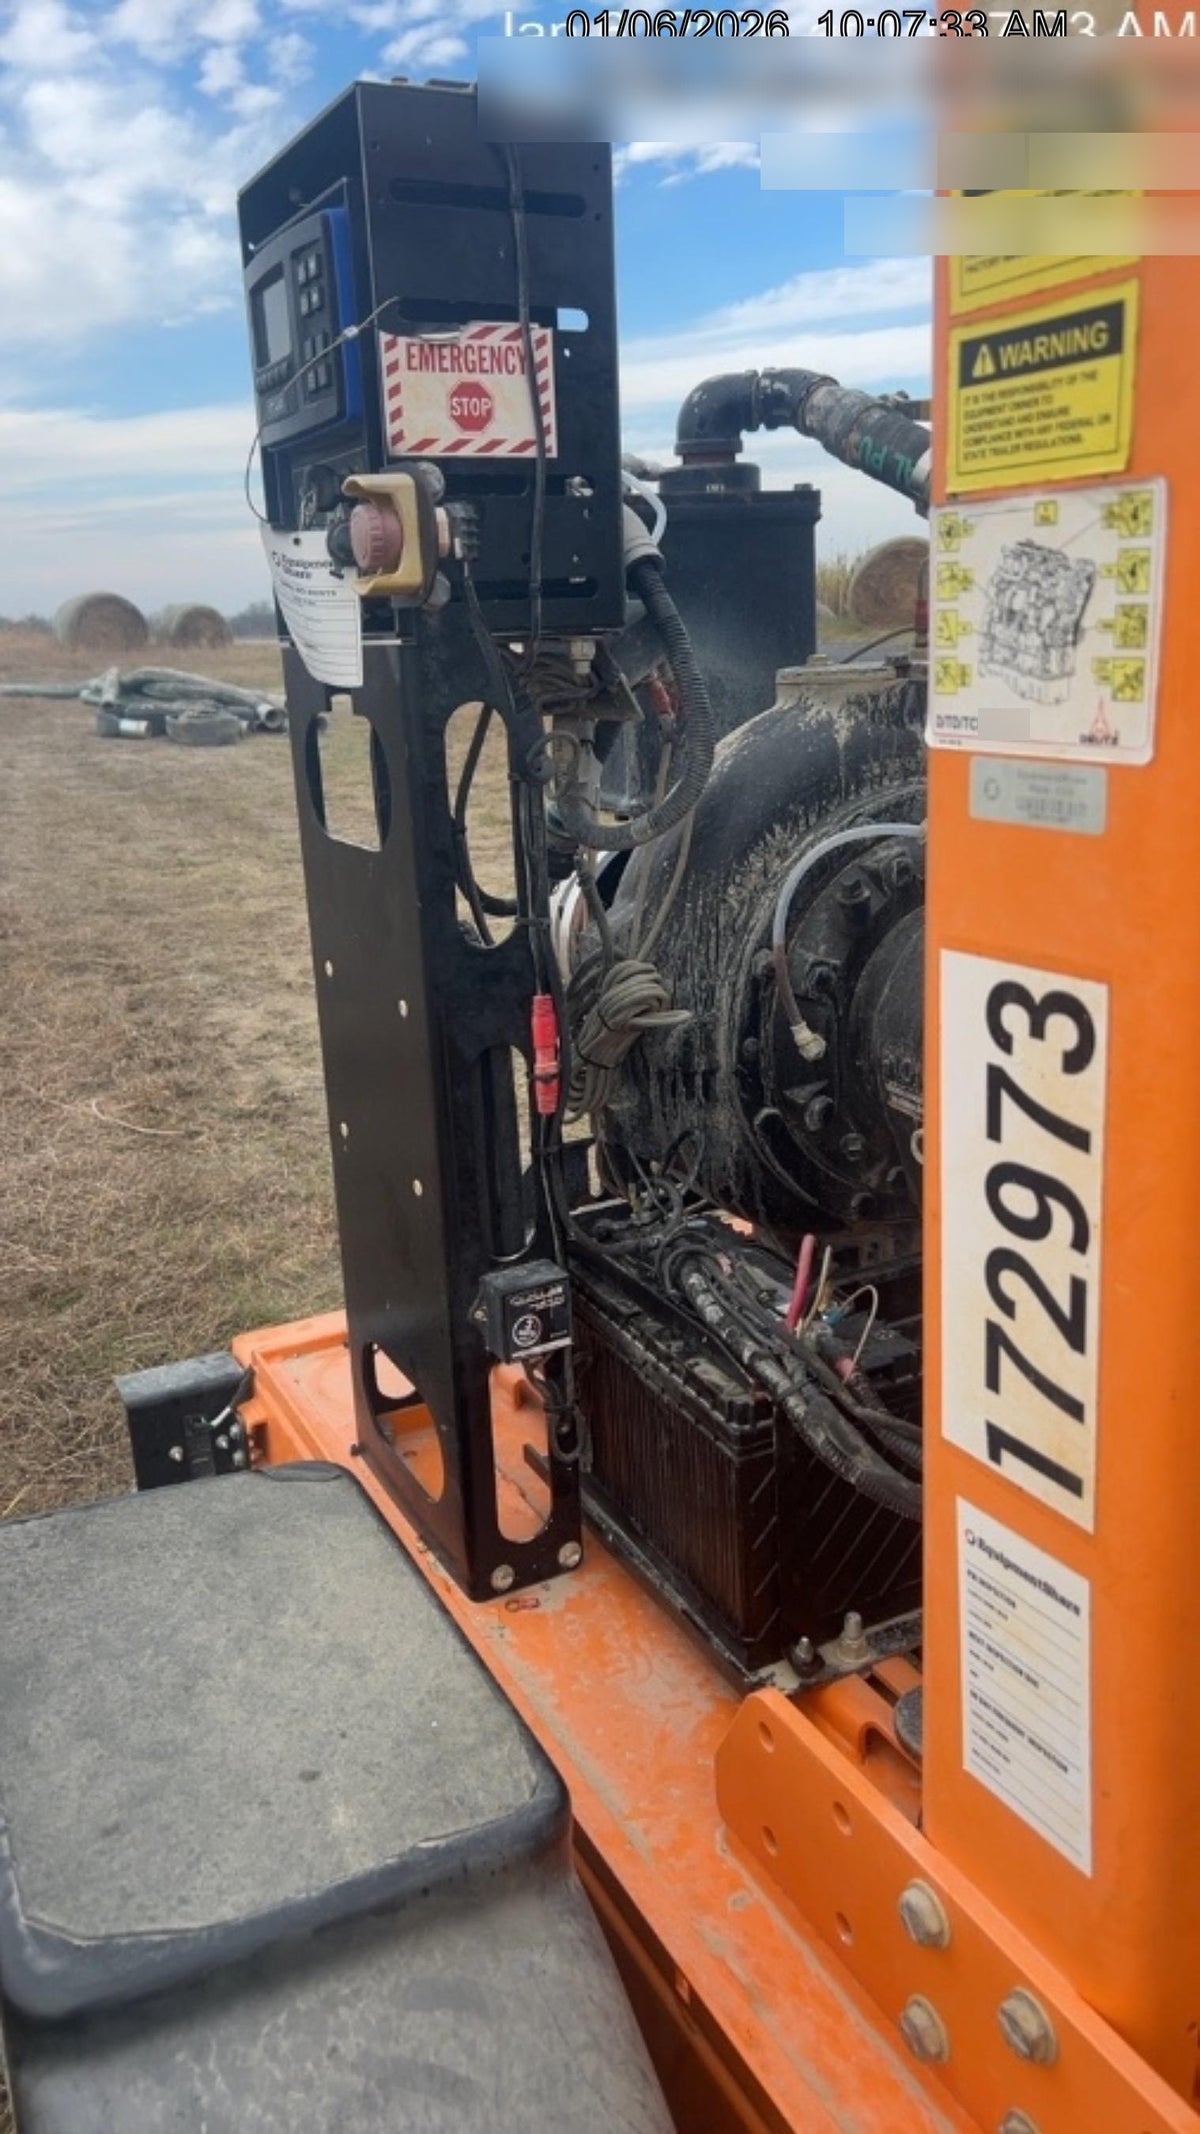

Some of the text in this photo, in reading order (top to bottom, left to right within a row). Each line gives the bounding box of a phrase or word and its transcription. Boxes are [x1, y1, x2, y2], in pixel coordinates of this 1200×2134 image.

[405, 341, 528, 375] EMERGENCY
[999, 320, 1109, 370] WARNING
[452, 397, 492, 417] STOP
[984, 980, 1097, 1499] 172973
